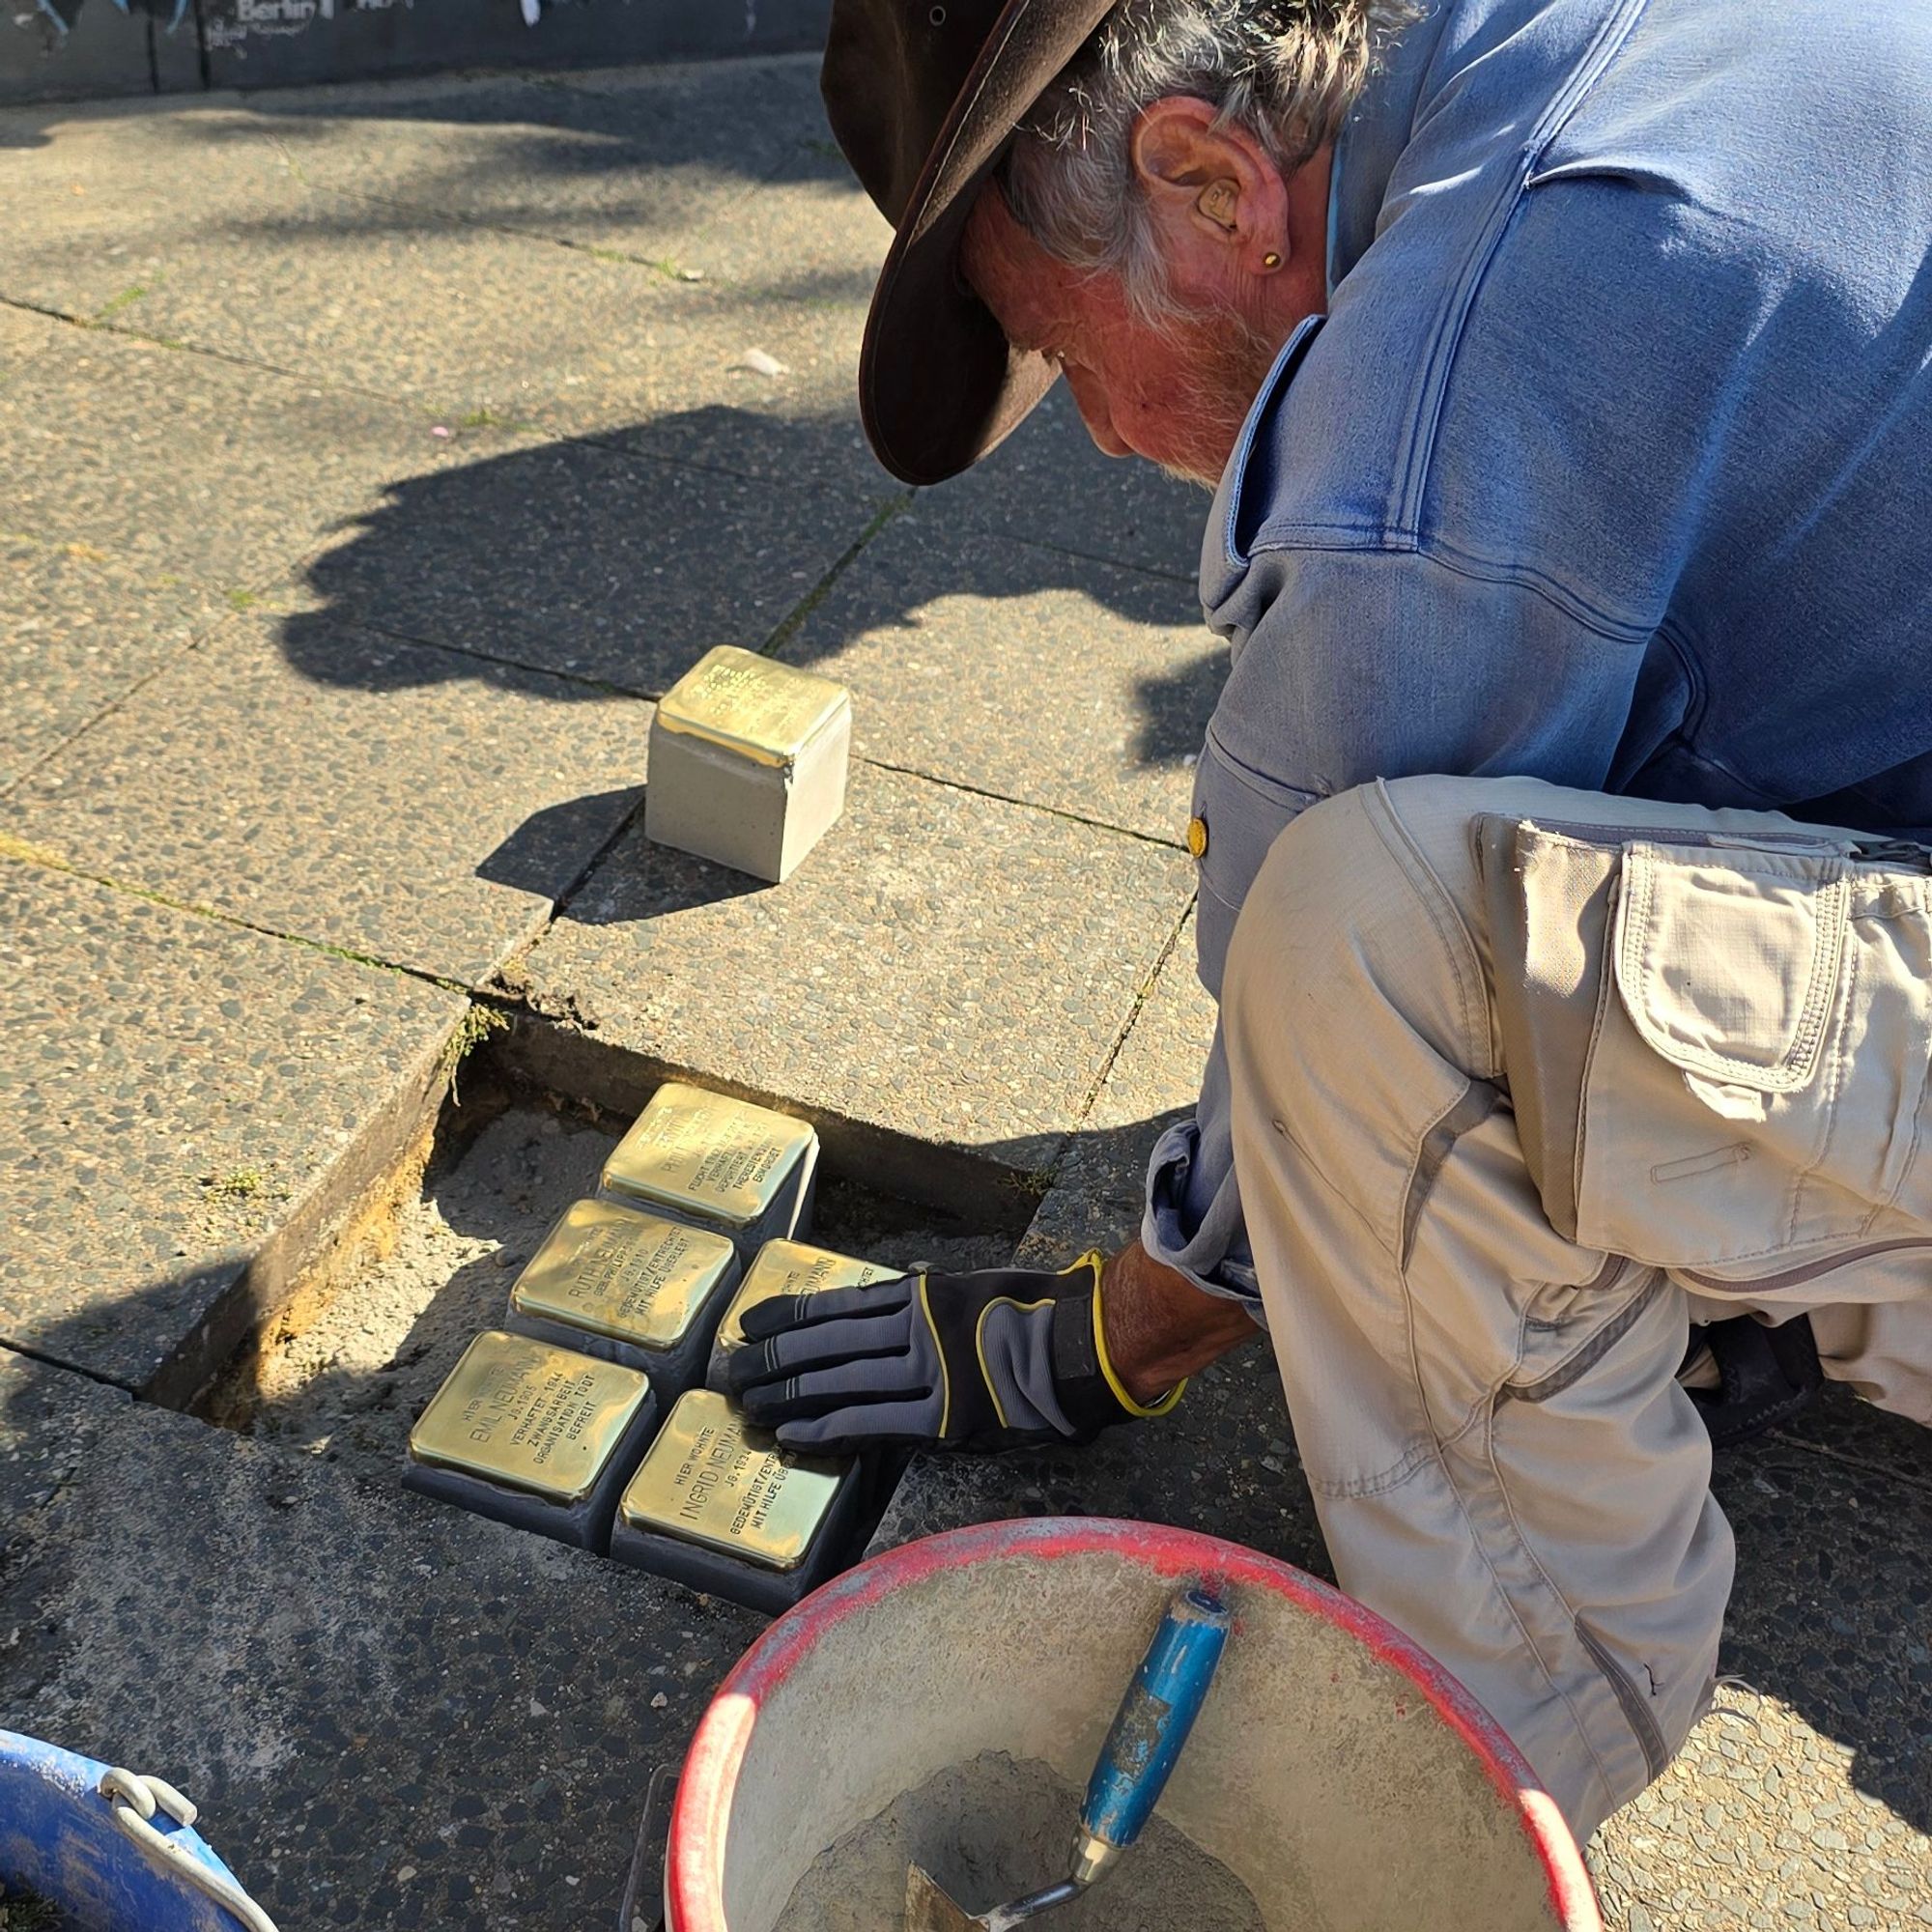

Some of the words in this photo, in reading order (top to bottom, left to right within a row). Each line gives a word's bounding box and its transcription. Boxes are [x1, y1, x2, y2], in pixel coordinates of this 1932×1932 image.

[568, 1266, 597, 1298] RUTH
[621, 1248, 649, 1282] JG.1910
[635, 1299, 651, 1316] MIT
[648, 1275, 667, 1298] HILFE
[463, 1400, 482, 1422] HIER
[469, 1412, 502, 1443] EMIL
[488, 1353, 541, 1411] NEUMANN
[508, 1383, 537, 1420] JG.1905
[510, 1396, 547, 1445] VERHAFTET
[544, 1371, 563, 1392] 1944
[527, 1379, 576, 1447] ZWANGSARBEIT
[533, 1401, 577, 1464] ORGANISATION
[575, 1373, 595, 1398] TODT
[566, 1401, 597, 1440] BEFREIT
[673, 1462, 692, 1486] HIER
[689, 1426, 714, 1462] WOHNTE
[680, 1471, 719, 1520] INGRID
[751, 1510, 768, 1529] MIT
[763, 1481, 782, 1511] HILFE
